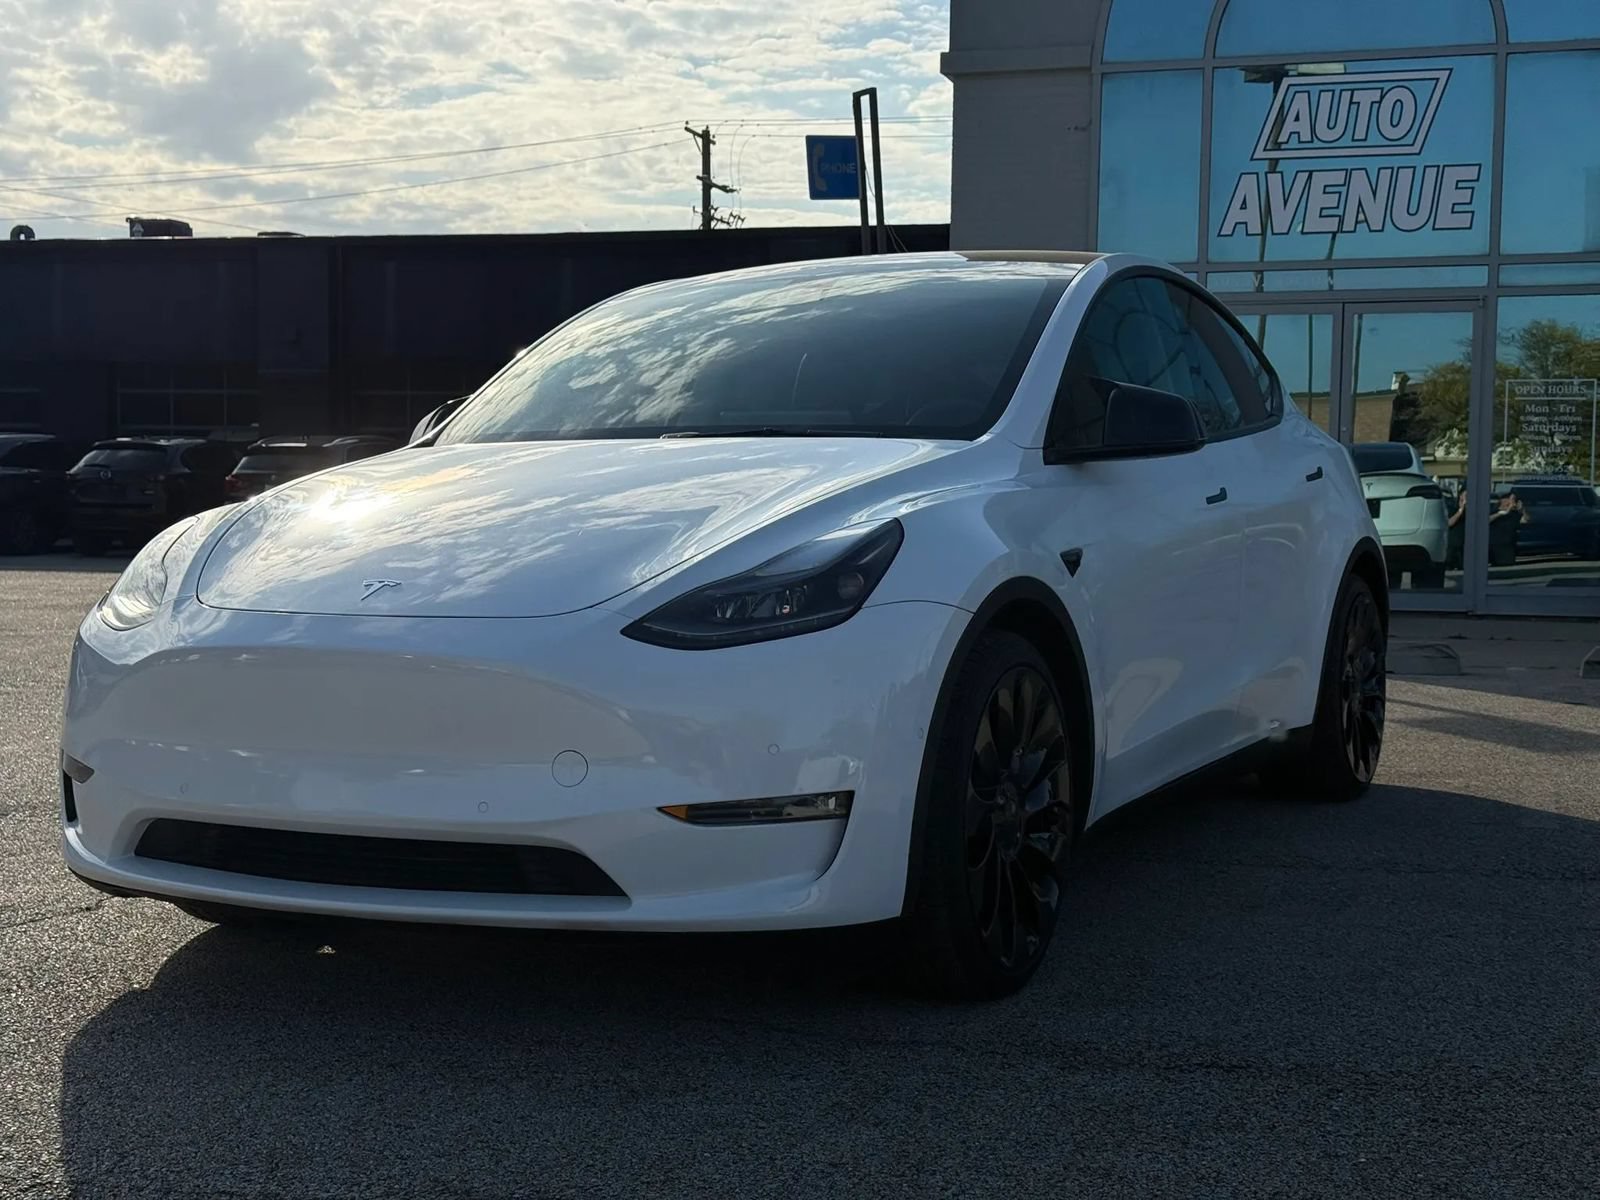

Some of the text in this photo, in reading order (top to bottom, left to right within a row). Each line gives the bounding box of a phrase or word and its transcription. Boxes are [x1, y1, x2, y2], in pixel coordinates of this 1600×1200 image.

[1277, 84, 1418, 144] AUTO
[820, 162, 857, 174] PHONE
[1217, 163, 1482, 237] AVENUE
[1515, 385, 1586, 394] OPEN HOURS
[1525, 404, 1549, 413] Mon
[1559, 404, 1576, 413] Fri
[1522, 423, 1577, 433] Saturdays
